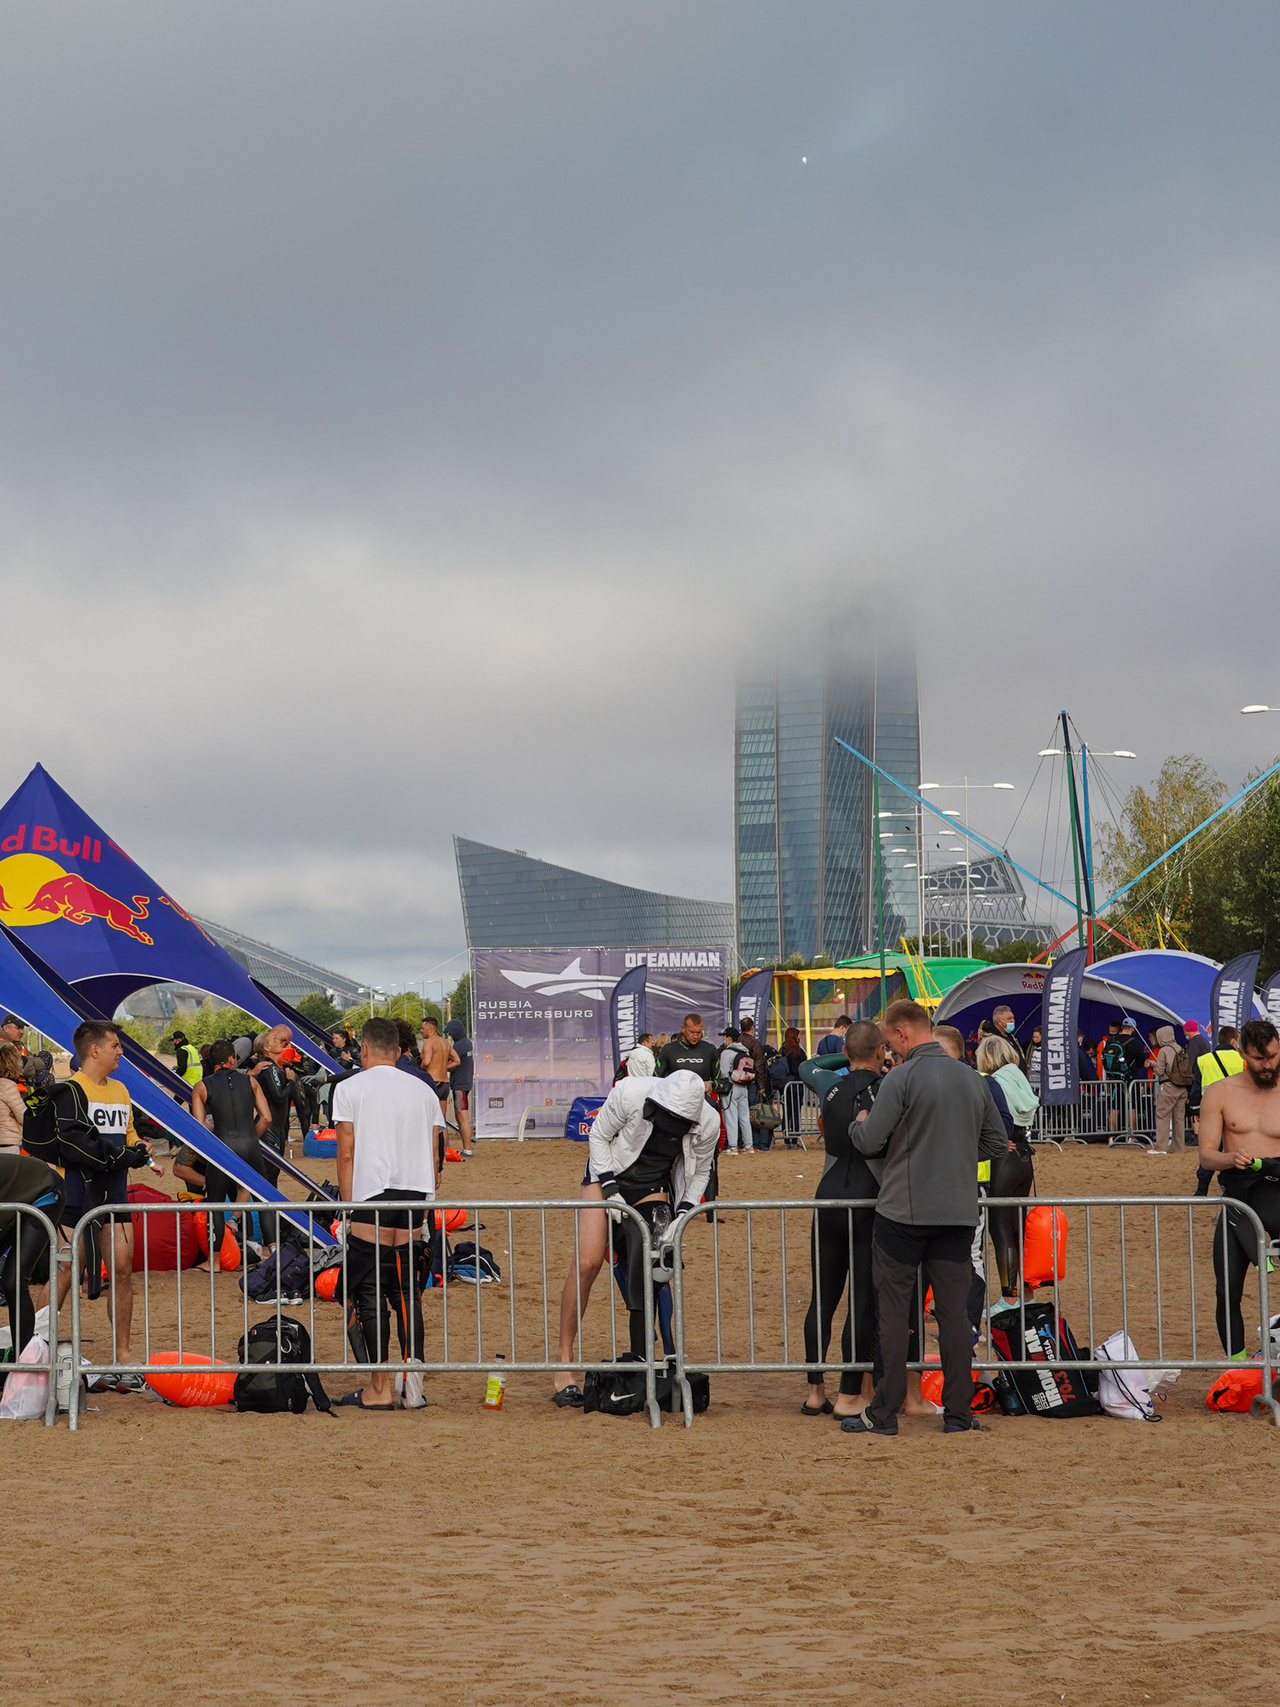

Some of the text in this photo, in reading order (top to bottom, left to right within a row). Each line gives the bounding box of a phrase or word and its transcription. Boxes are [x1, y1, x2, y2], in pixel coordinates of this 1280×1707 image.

[32, 825, 101, 863] Bull
[625, 952, 720, 967] OCEANMAN
[478, 1010, 594, 1020] ST.PETERSBURG
[479, 1000, 533, 1009] RUSSIA
[1047, 975, 1070, 1090] OCEANMAN
[1053, 1370, 1076, 1403] 70.3
